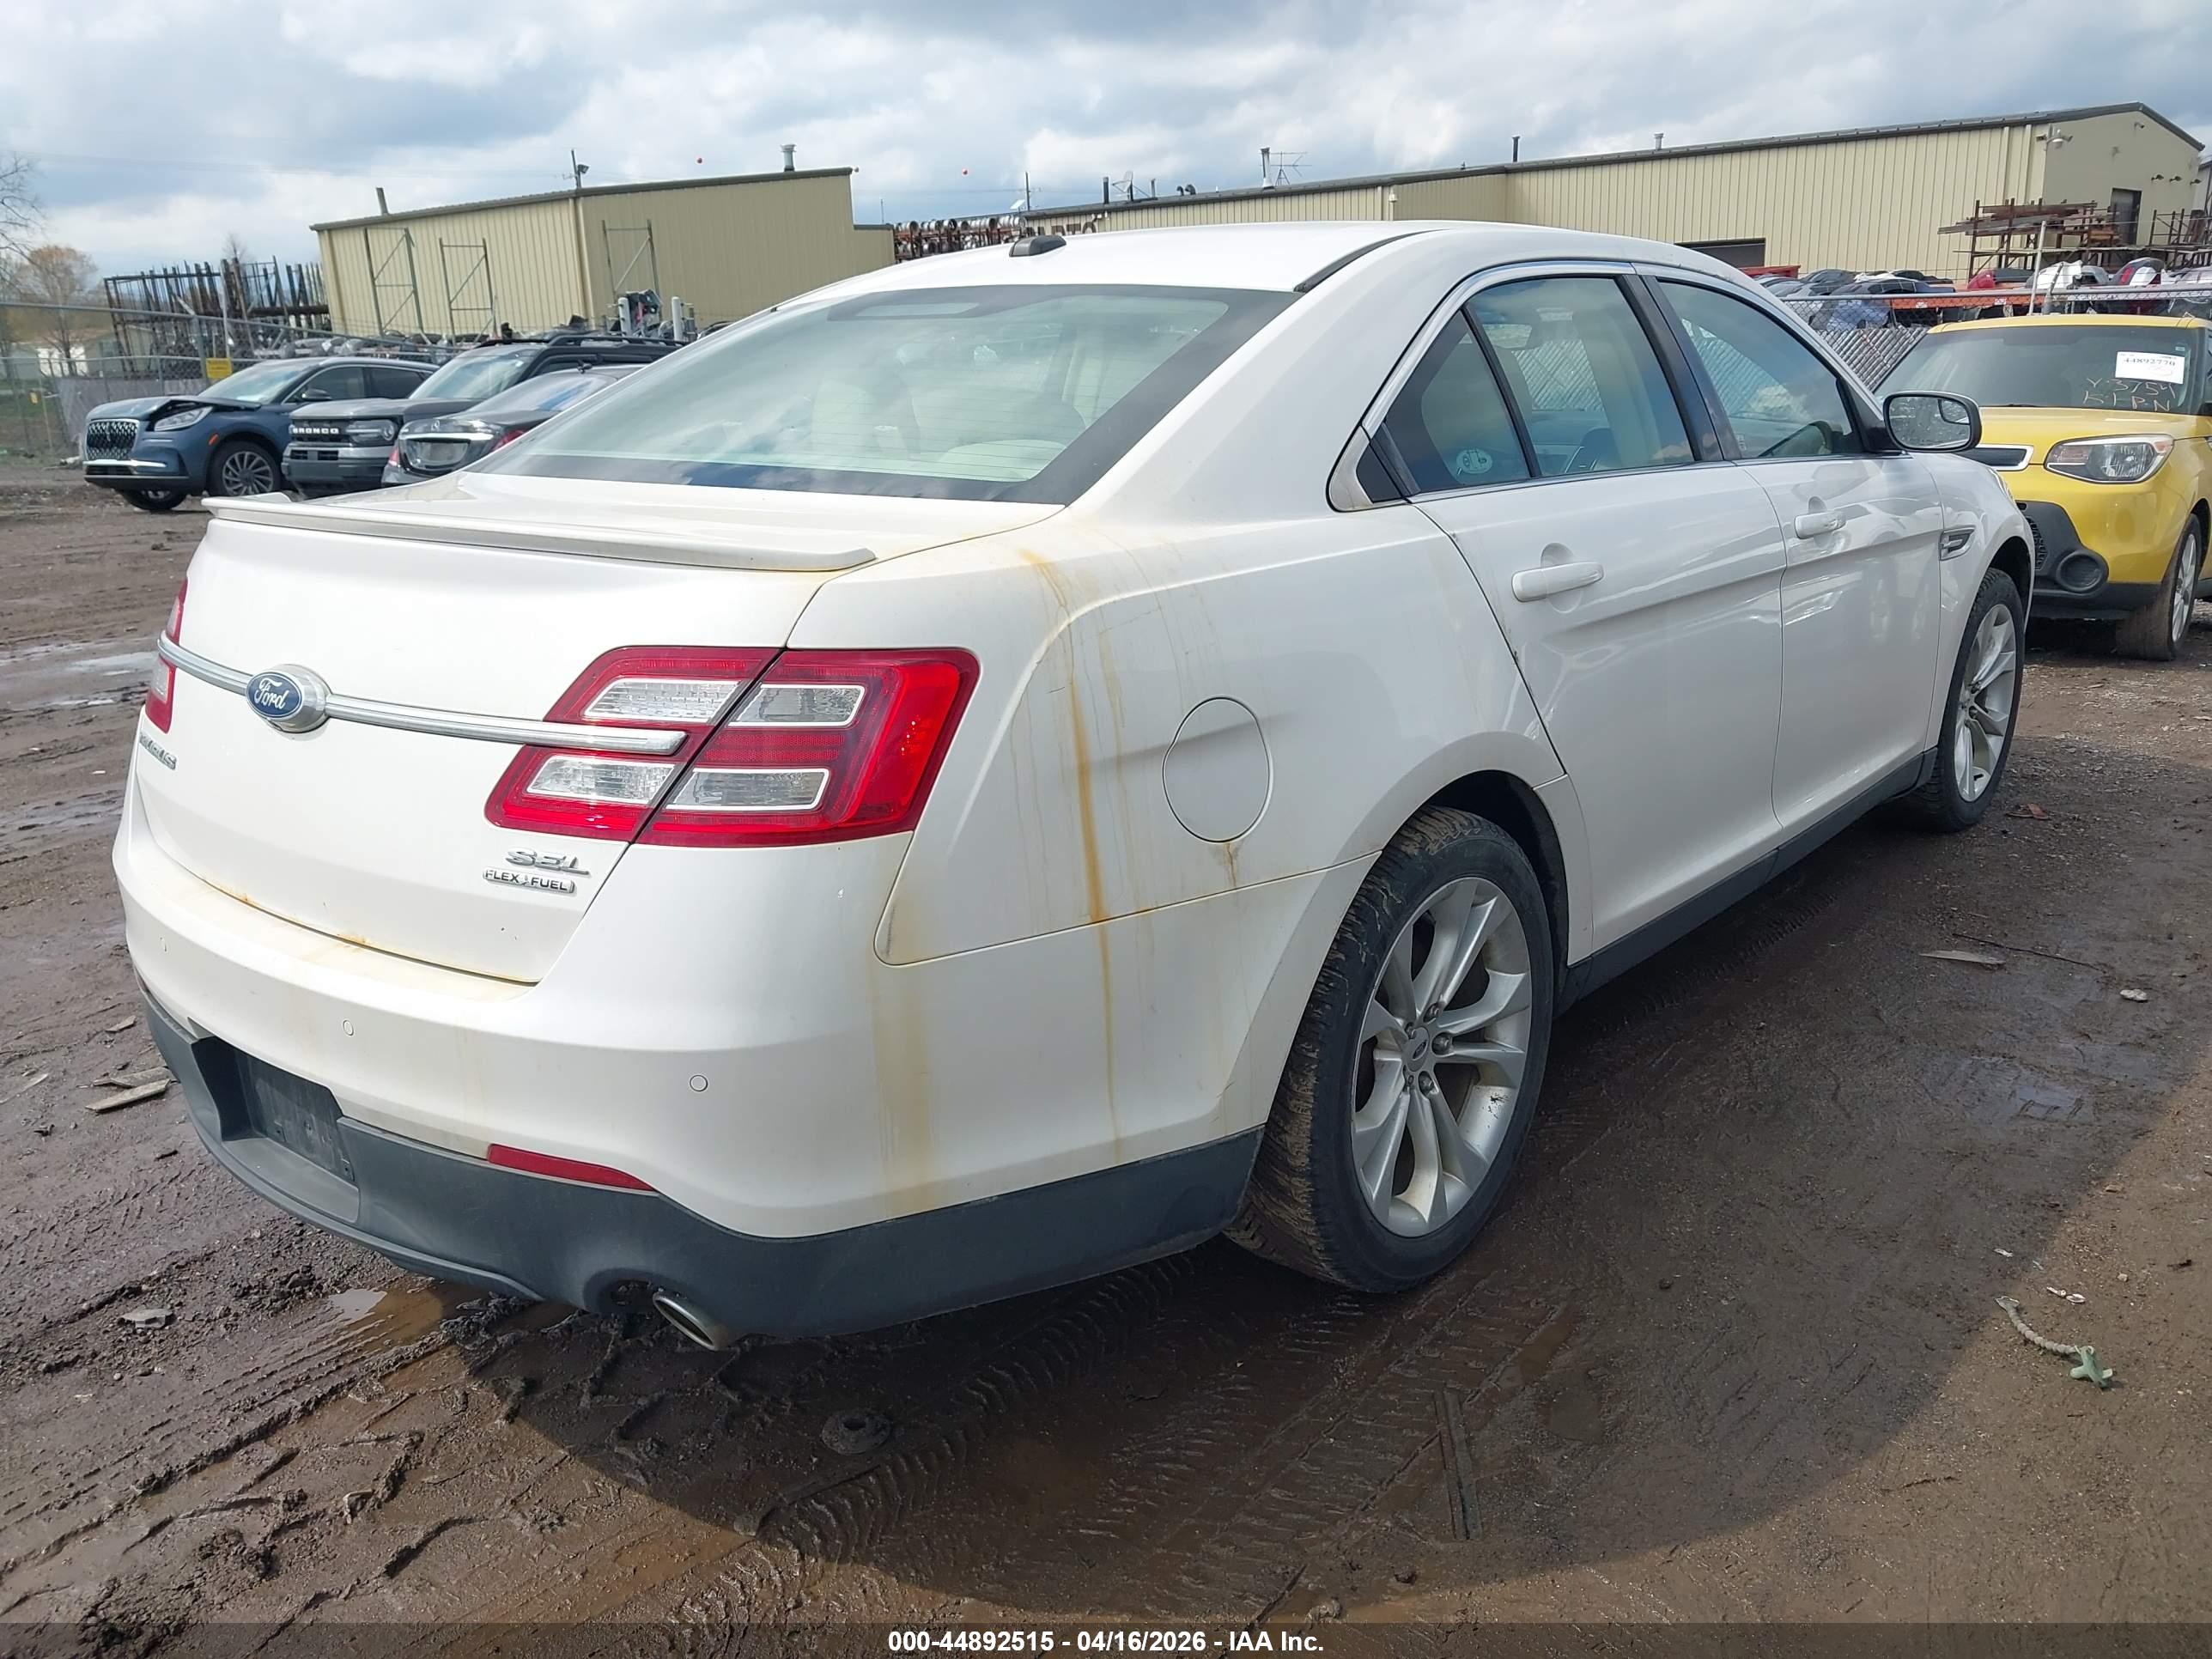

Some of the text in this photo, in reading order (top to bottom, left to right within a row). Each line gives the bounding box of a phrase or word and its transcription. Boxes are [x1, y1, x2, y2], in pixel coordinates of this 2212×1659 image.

[253, 678, 290, 710] Ford
[505, 848, 590, 876] SEL
[485, 869, 568, 891] FLEX FUEL
